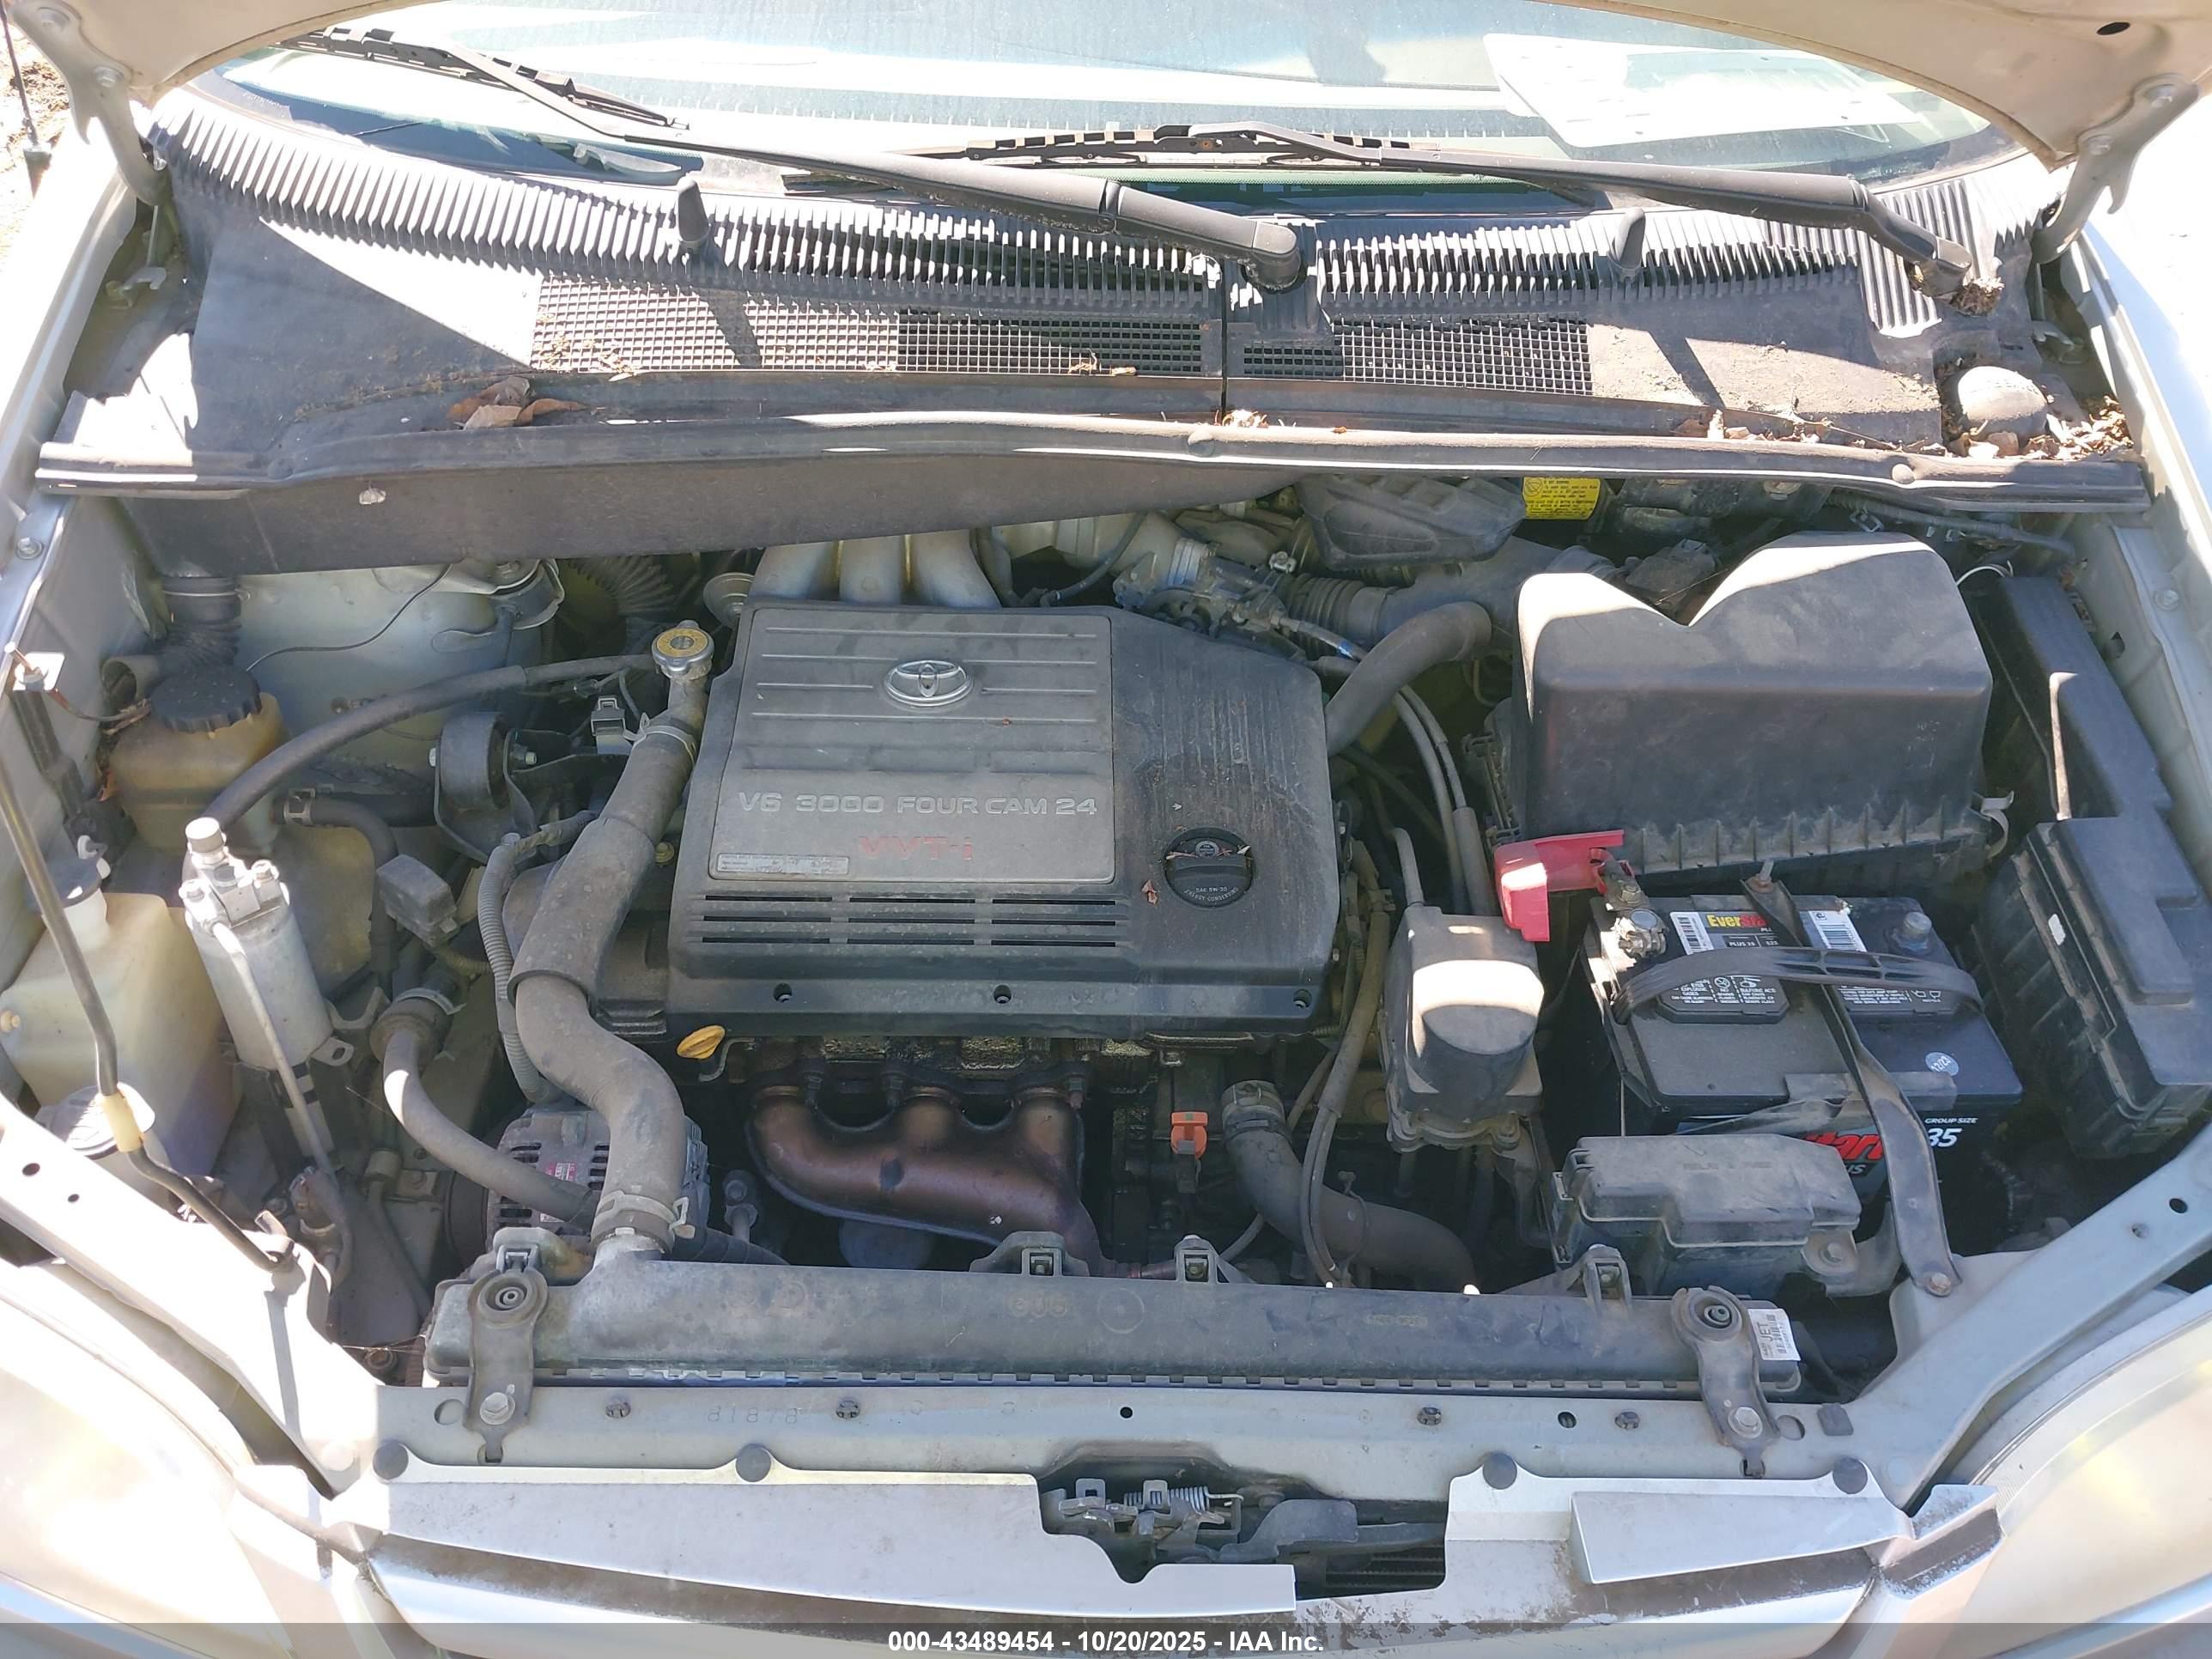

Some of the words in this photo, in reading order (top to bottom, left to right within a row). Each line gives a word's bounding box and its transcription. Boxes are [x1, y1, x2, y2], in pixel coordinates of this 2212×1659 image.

[738, 792, 782, 812] V6
[795, 793, 884, 813] 3000
[896, 795, 979, 815] FOUR
[985, 796, 1048, 815] CAM
[1055, 798, 1097, 816] 24
[1927, 1127, 1962, 1147] 35
[1757, 1322, 1773, 1341] JET
